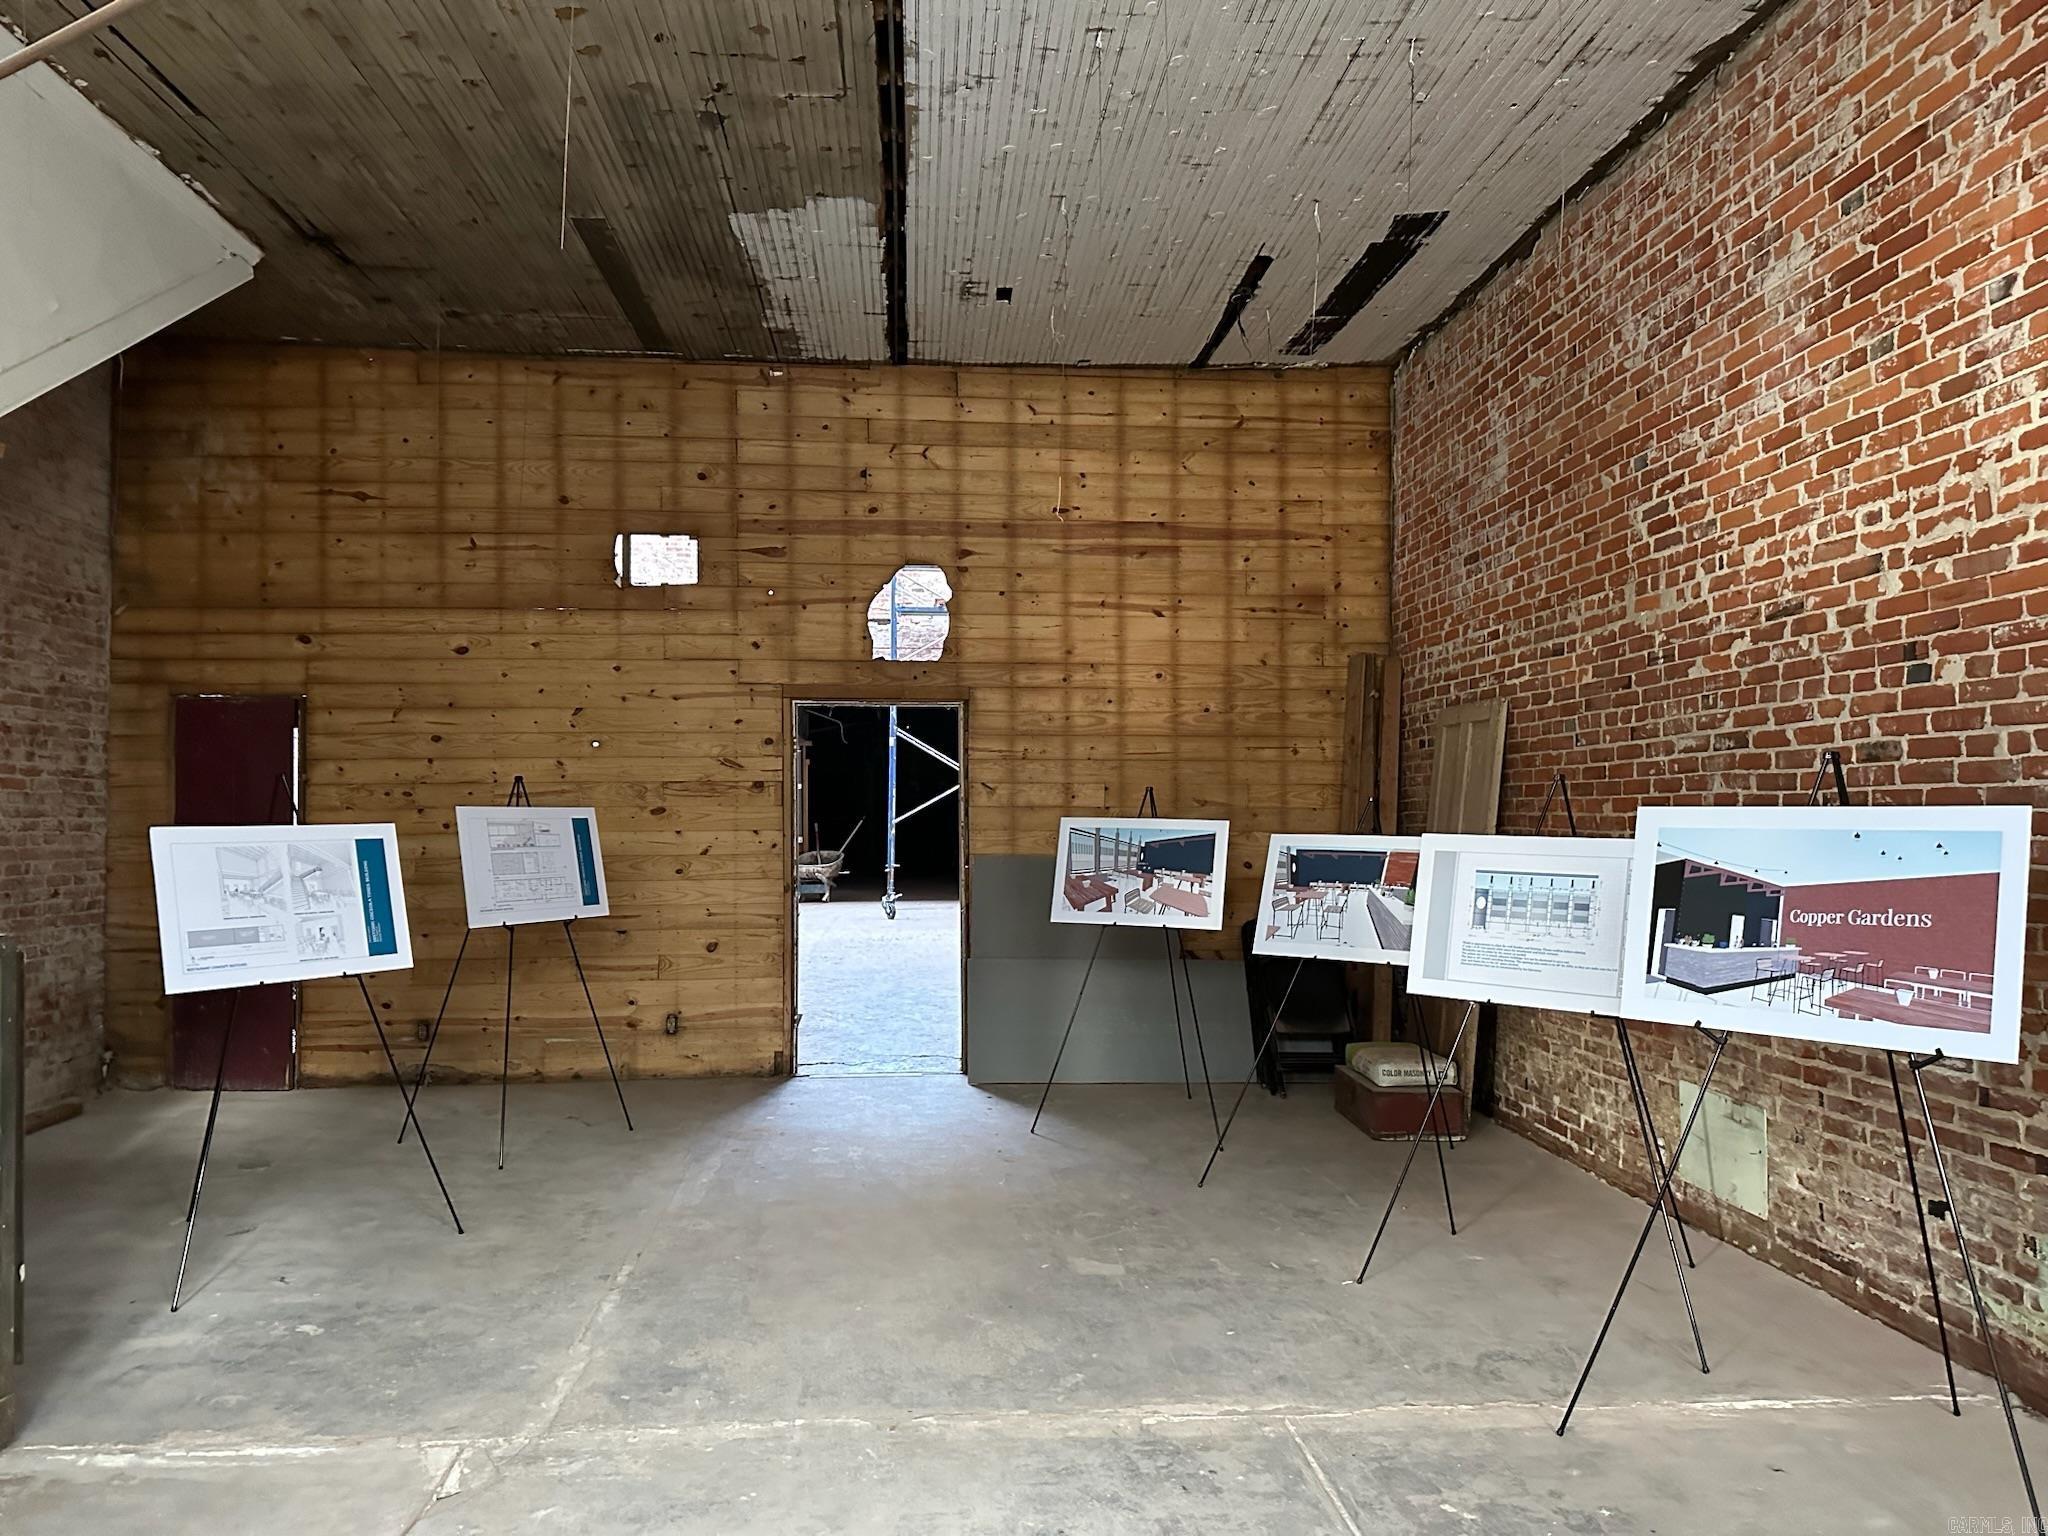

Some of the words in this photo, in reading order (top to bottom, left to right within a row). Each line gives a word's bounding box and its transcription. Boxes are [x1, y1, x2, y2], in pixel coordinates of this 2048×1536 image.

[1789, 909, 1845, 927] Copper
[1847, 908, 1933, 928] Gardens
[1381, 1069, 1402, 1077] COLOR
[1403, 1069, 1431, 1077] MASONY
